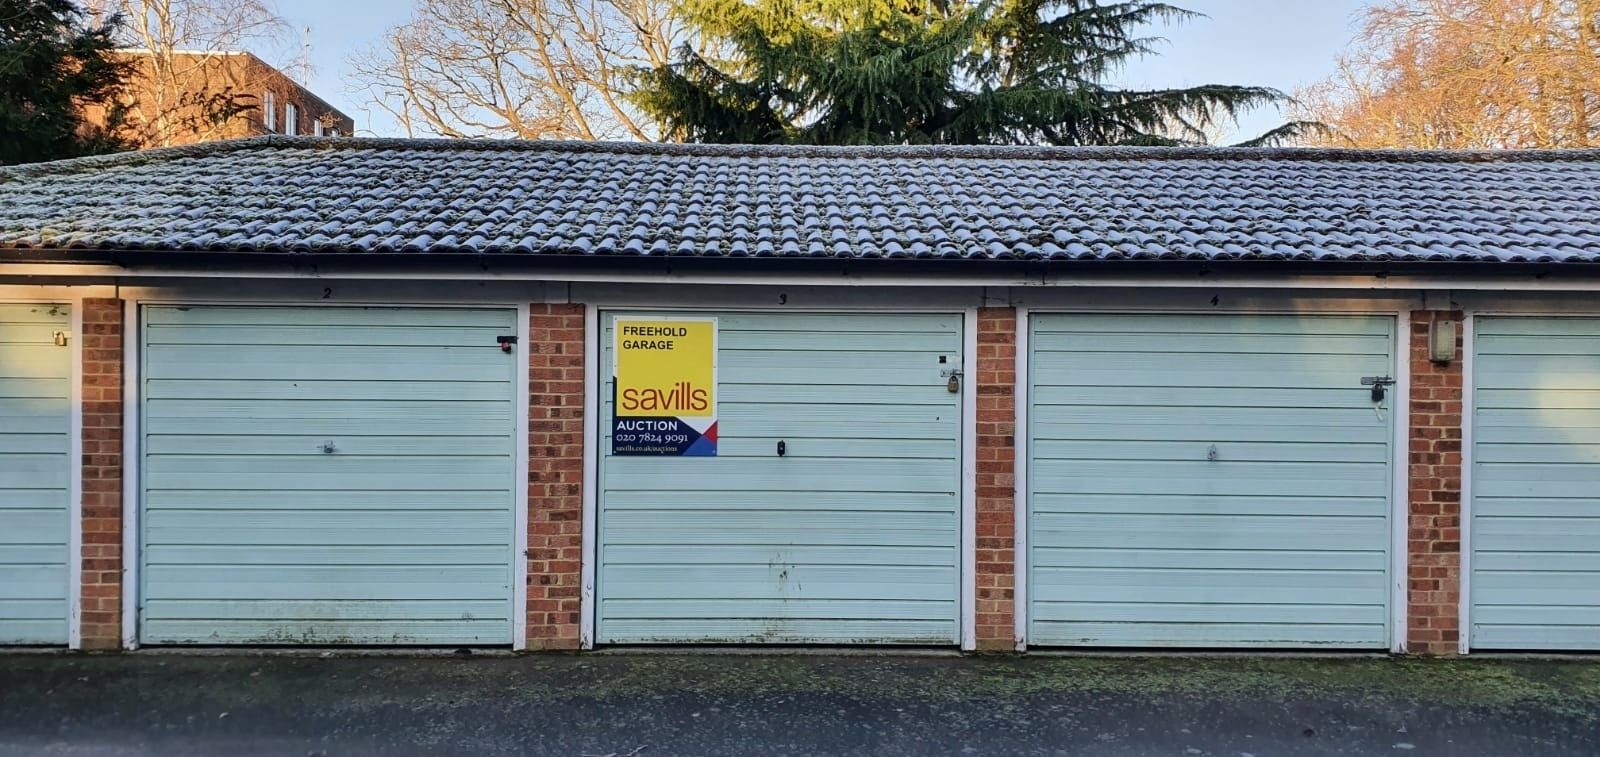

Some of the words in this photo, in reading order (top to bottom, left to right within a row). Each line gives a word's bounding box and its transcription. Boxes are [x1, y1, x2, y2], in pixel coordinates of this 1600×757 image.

[323, 287, 332, 299] 2
[1210, 294, 1219, 307] 4
[623, 326, 688, 337] FREEHOLD
[622, 340, 674, 350] GARAGE
[622, 381, 708, 411] savills
[616, 420, 678, 431] AUCTION
[616, 434, 636, 442] 020
[639, 432, 662, 444] 7824
[665, 434, 688, 444] 9091
